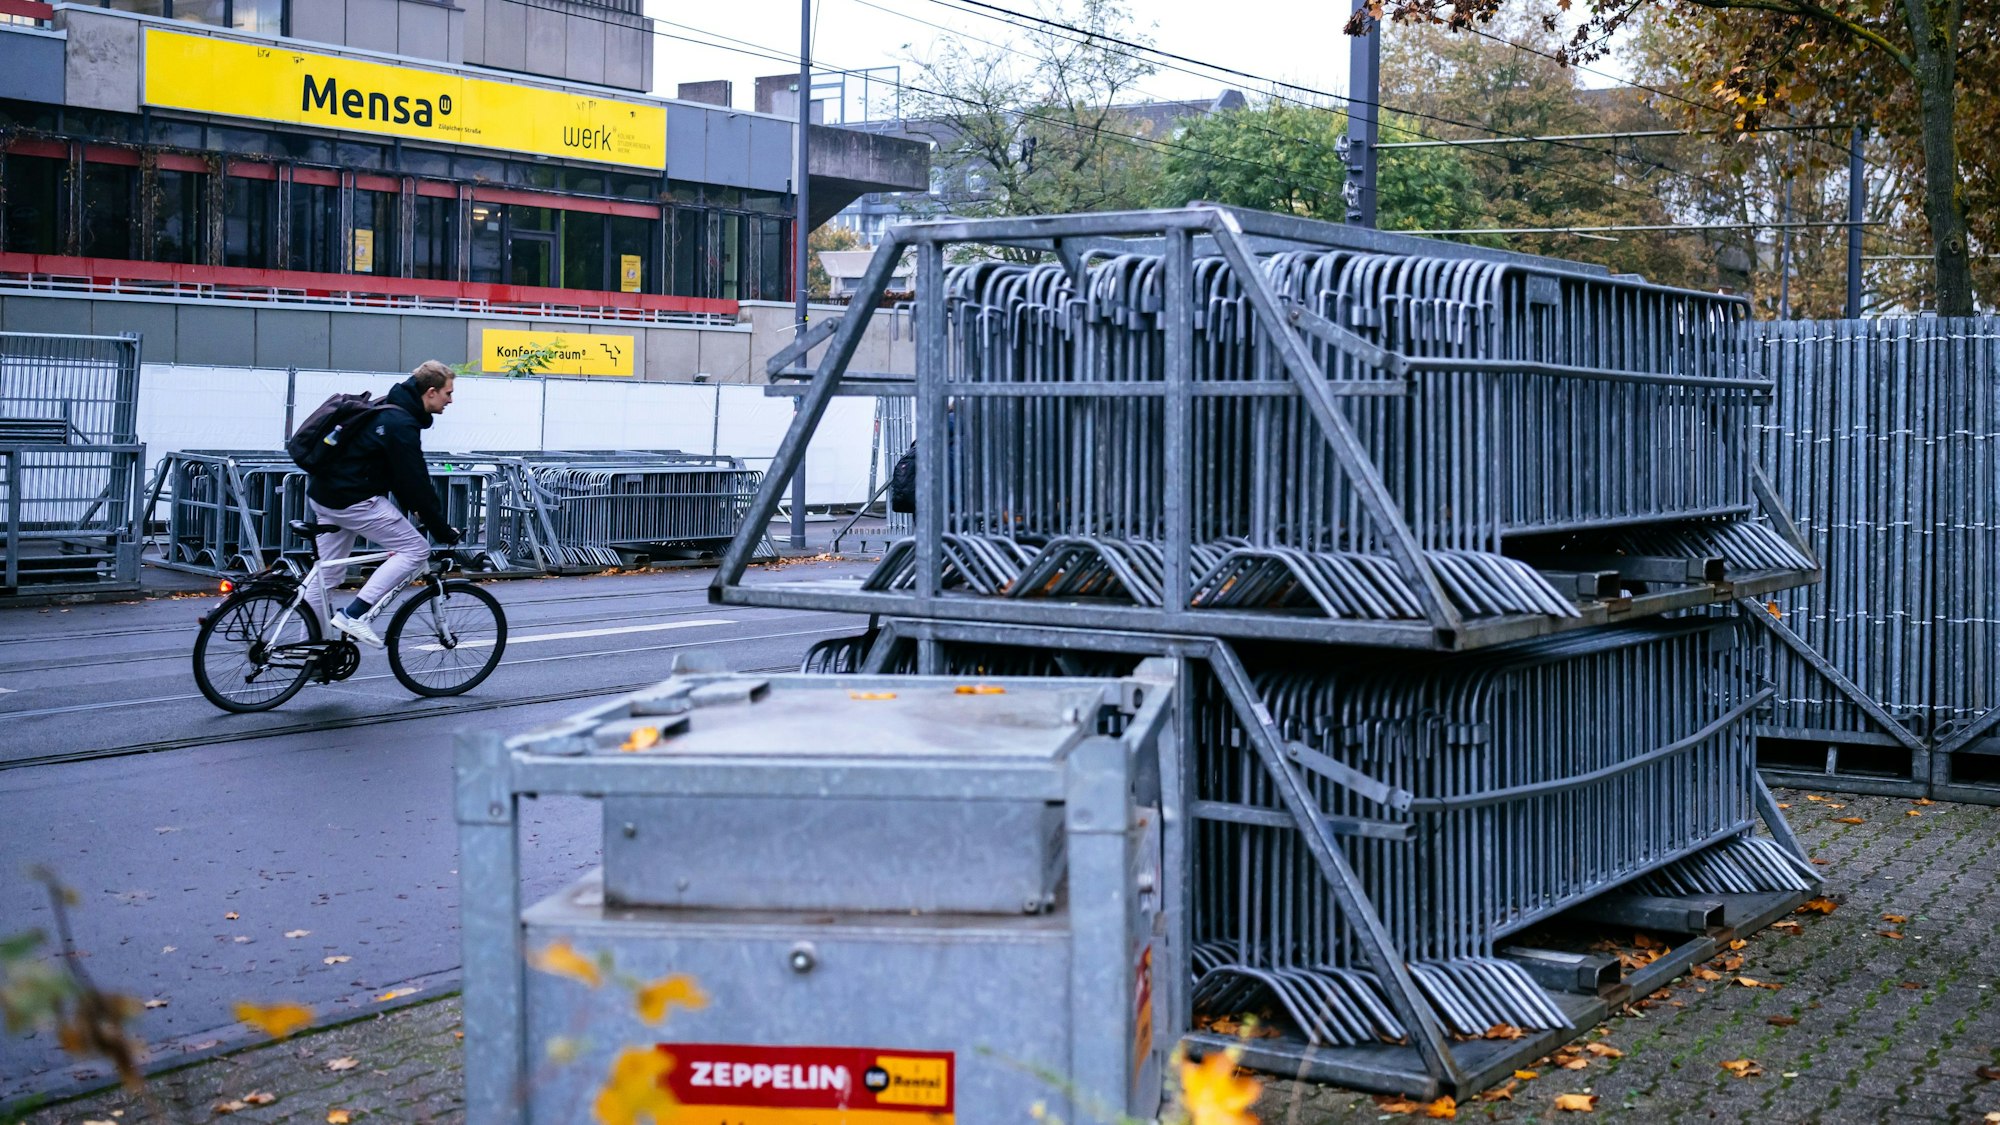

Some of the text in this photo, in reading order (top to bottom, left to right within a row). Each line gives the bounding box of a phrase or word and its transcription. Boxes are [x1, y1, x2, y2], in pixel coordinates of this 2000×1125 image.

[302, 74, 433, 127] Mensa
[563, 124, 612, 151] werk
[690, 1061, 846, 1090] ZEPPELIN
[894, 1075, 941, 1089] Rental
